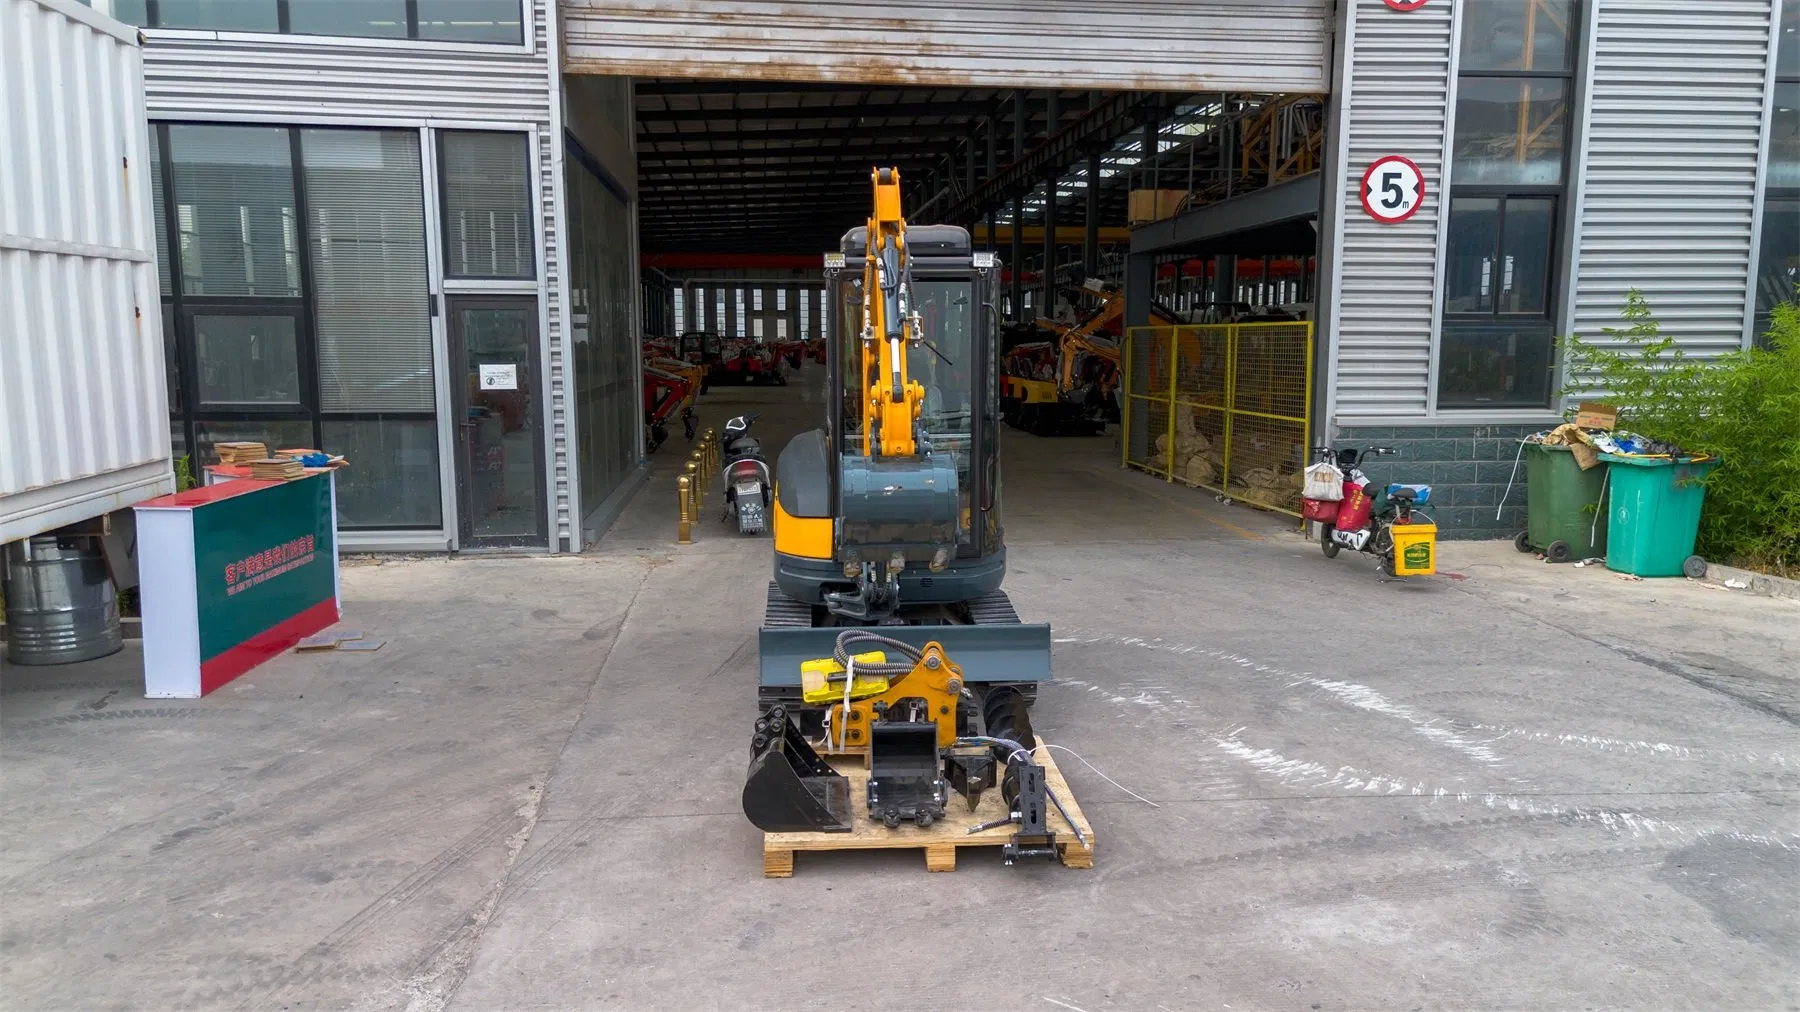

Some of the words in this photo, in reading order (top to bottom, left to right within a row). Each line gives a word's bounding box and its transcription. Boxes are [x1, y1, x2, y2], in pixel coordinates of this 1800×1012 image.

[225, 534, 313, 585] 客户满意是我们的宗旨
